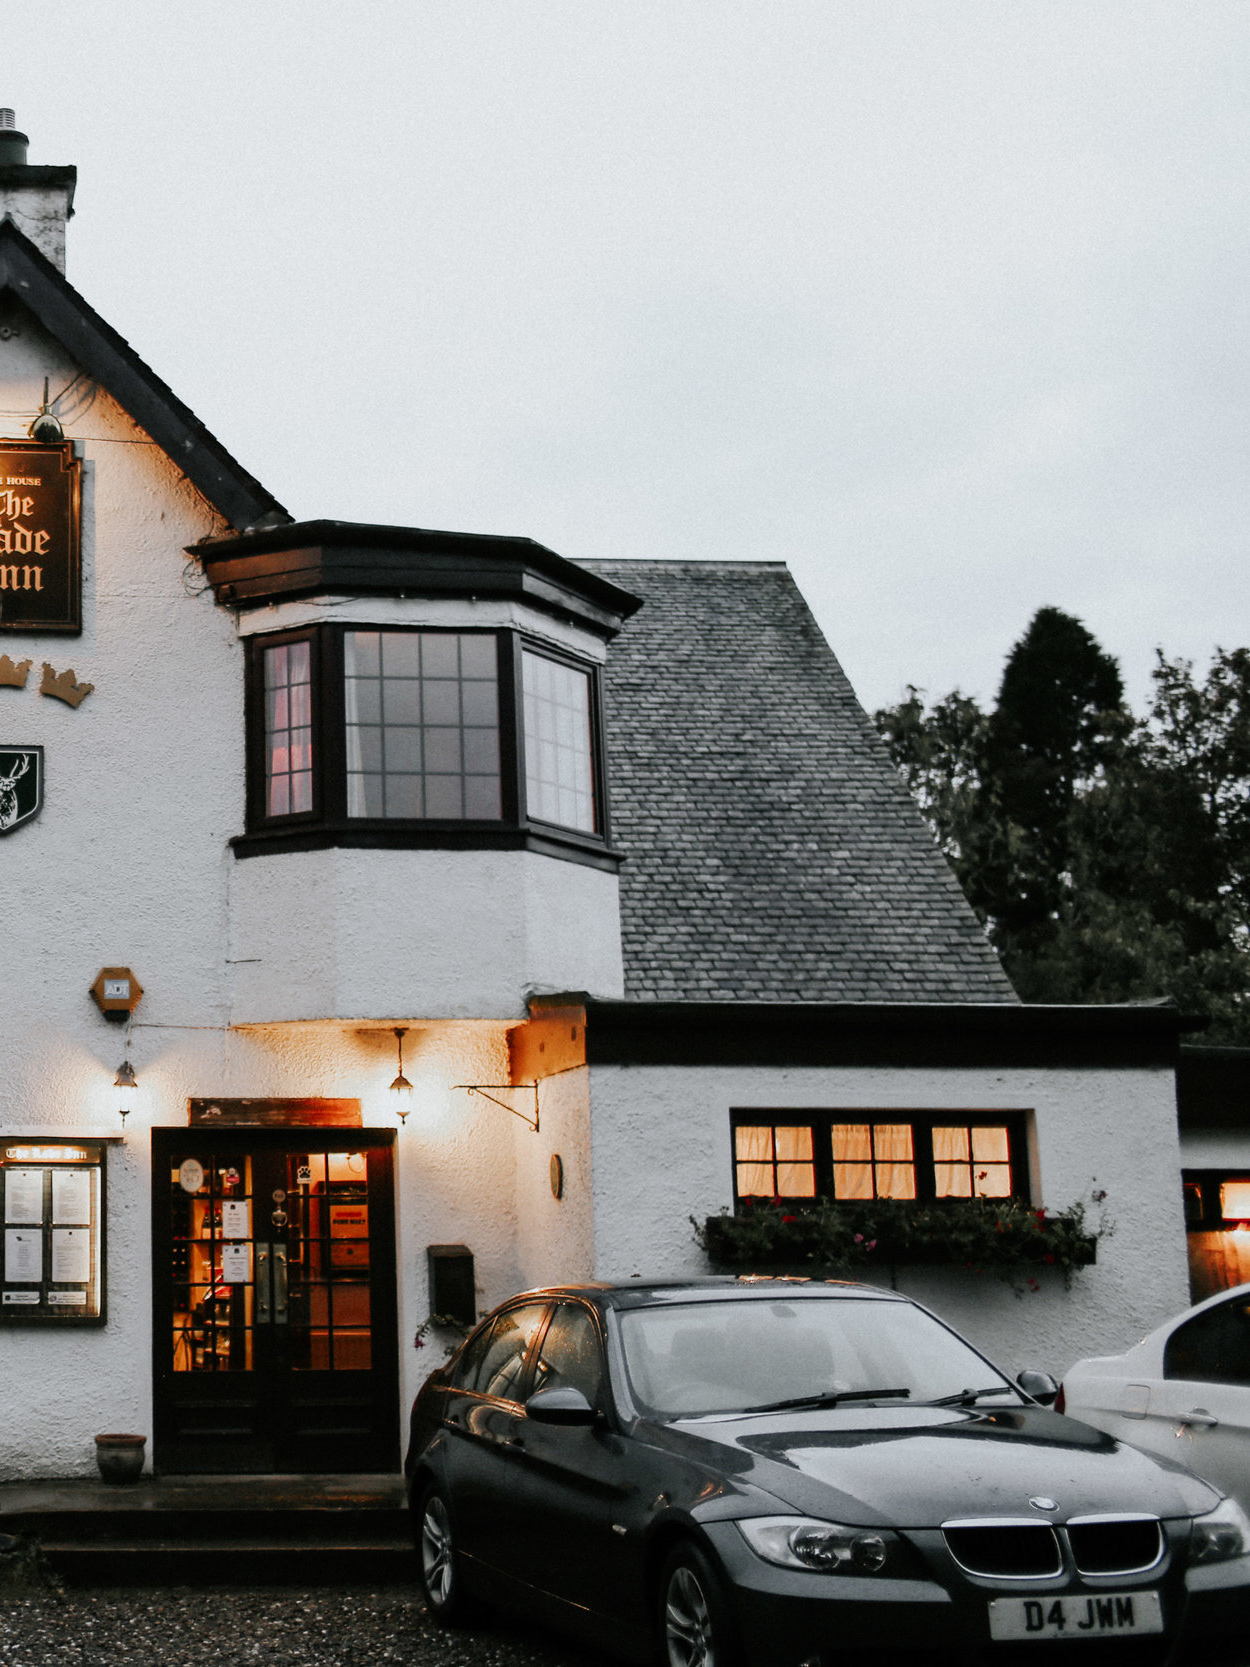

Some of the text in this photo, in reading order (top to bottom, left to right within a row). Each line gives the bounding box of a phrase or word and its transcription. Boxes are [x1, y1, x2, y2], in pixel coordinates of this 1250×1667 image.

[6, 477, 41, 486] HOUSE
[105, 984, 127, 995] ADT
[6, 1147, 29, 1160] The
[1023, 1596, 1135, 1631] D4 JWM
